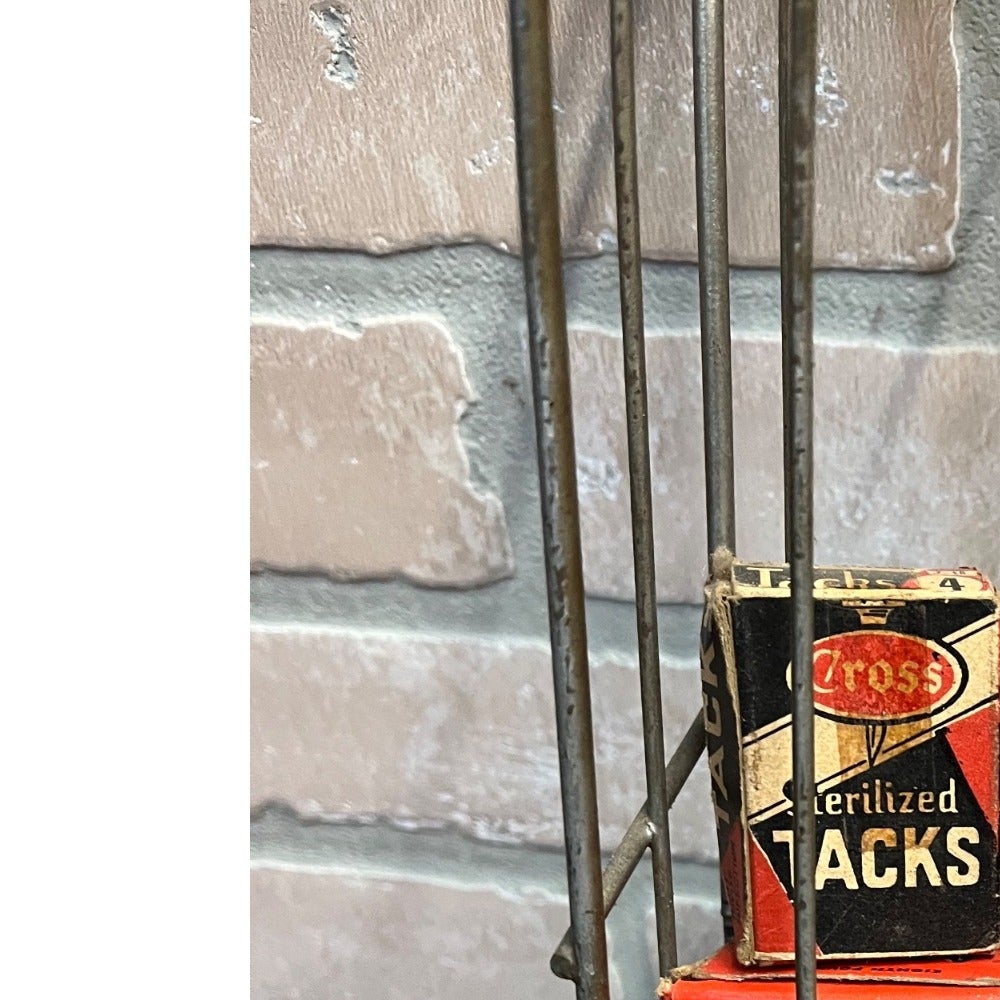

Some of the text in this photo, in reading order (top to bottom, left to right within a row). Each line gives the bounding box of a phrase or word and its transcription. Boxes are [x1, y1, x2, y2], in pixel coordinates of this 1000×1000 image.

[939, 577, 965, 591] 4
[813, 647, 943, 695] Cross
[781, 777, 958, 816] terilized
